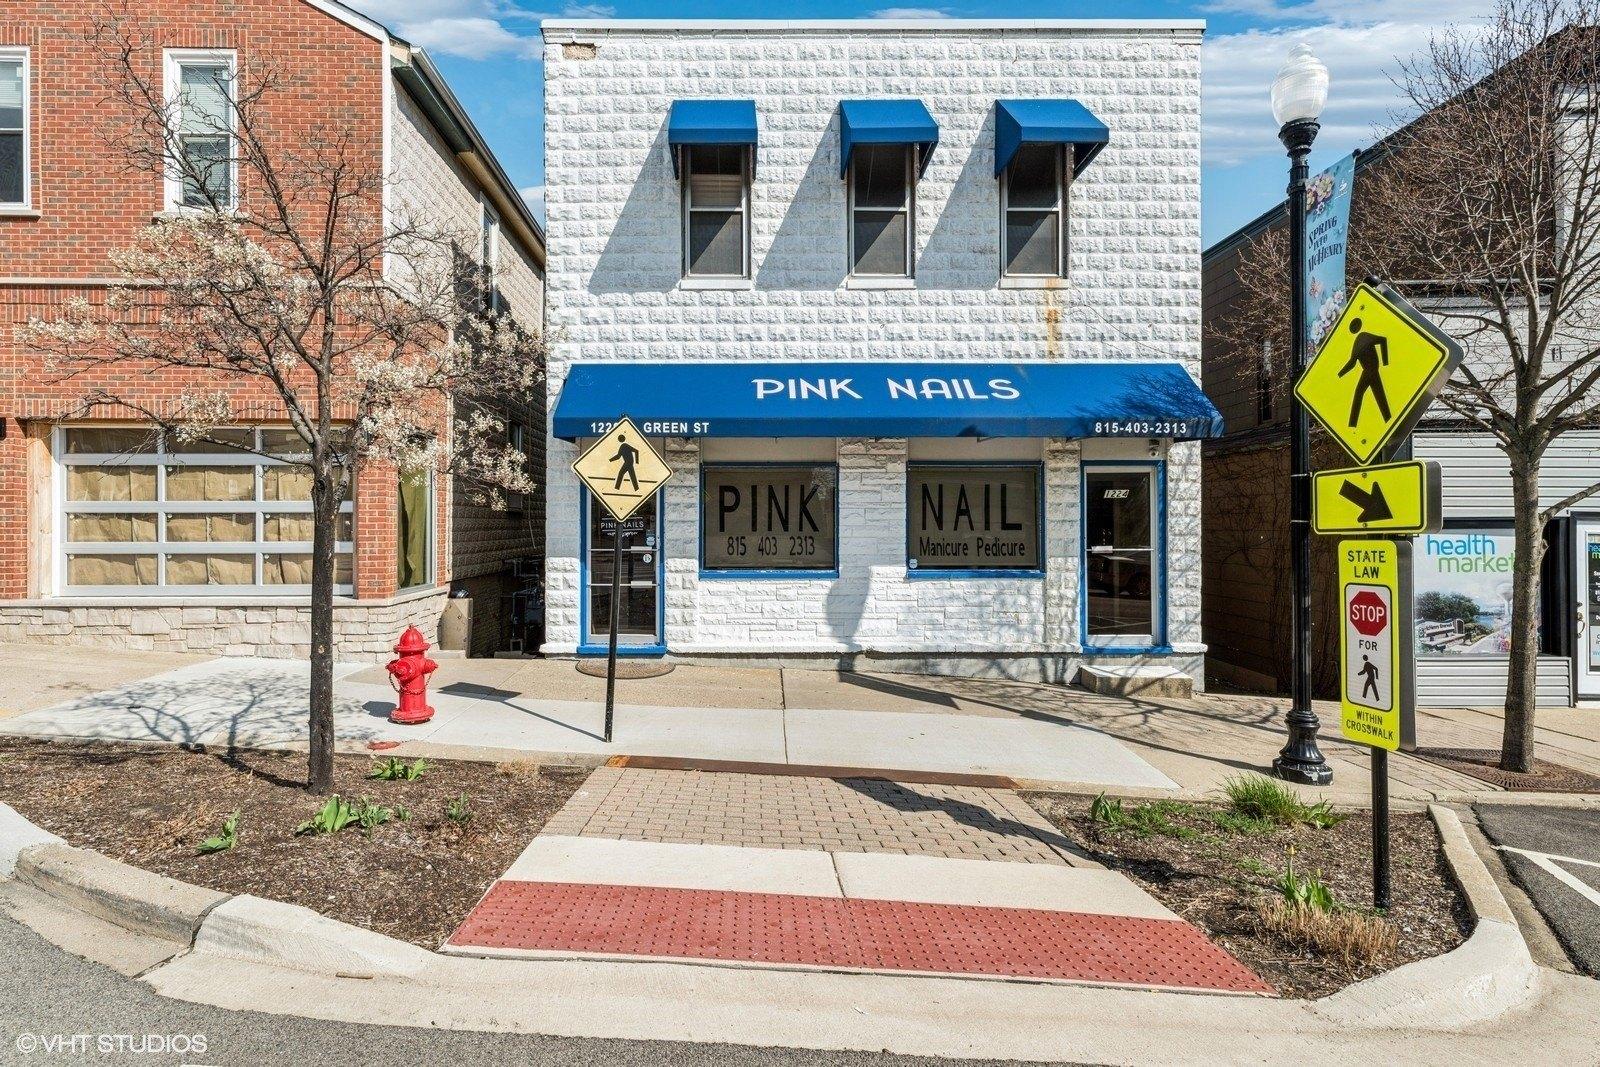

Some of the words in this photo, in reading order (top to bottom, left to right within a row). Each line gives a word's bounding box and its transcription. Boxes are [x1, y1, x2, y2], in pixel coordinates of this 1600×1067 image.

[1308, 216, 1337, 249] SPRING
[751, 378, 863, 400] PINK
[887, 378, 1020, 400] NAILS
[643, 422, 688, 434] GREEN
[693, 422, 710, 434] ST
[1095, 422, 1187, 434] 815-403-2313
[1104, 489, 1129, 499] 1224
[719, 484, 820, 533] PINK
[921, 483, 1023, 532] NAIL
[727, 535, 747, 557] 815
[758, 535, 778, 557] 403
[789, 535, 815, 557] 2313
[920, 536, 969, 558] Manicure
[976, 536, 1026, 558] Pedicure
[1427, 534, 1496, 556] health
[1347, 550, 1386, 563] STATE
[1354, 566, 1380, 579] LAW
[1351, 604, 1385, 623] STOP
[1358, 639, 1378, 651] FOR
[1355, 710, 1383, 726] WITHIN
[1345, 719, 1394, 741] CROSSWALK
